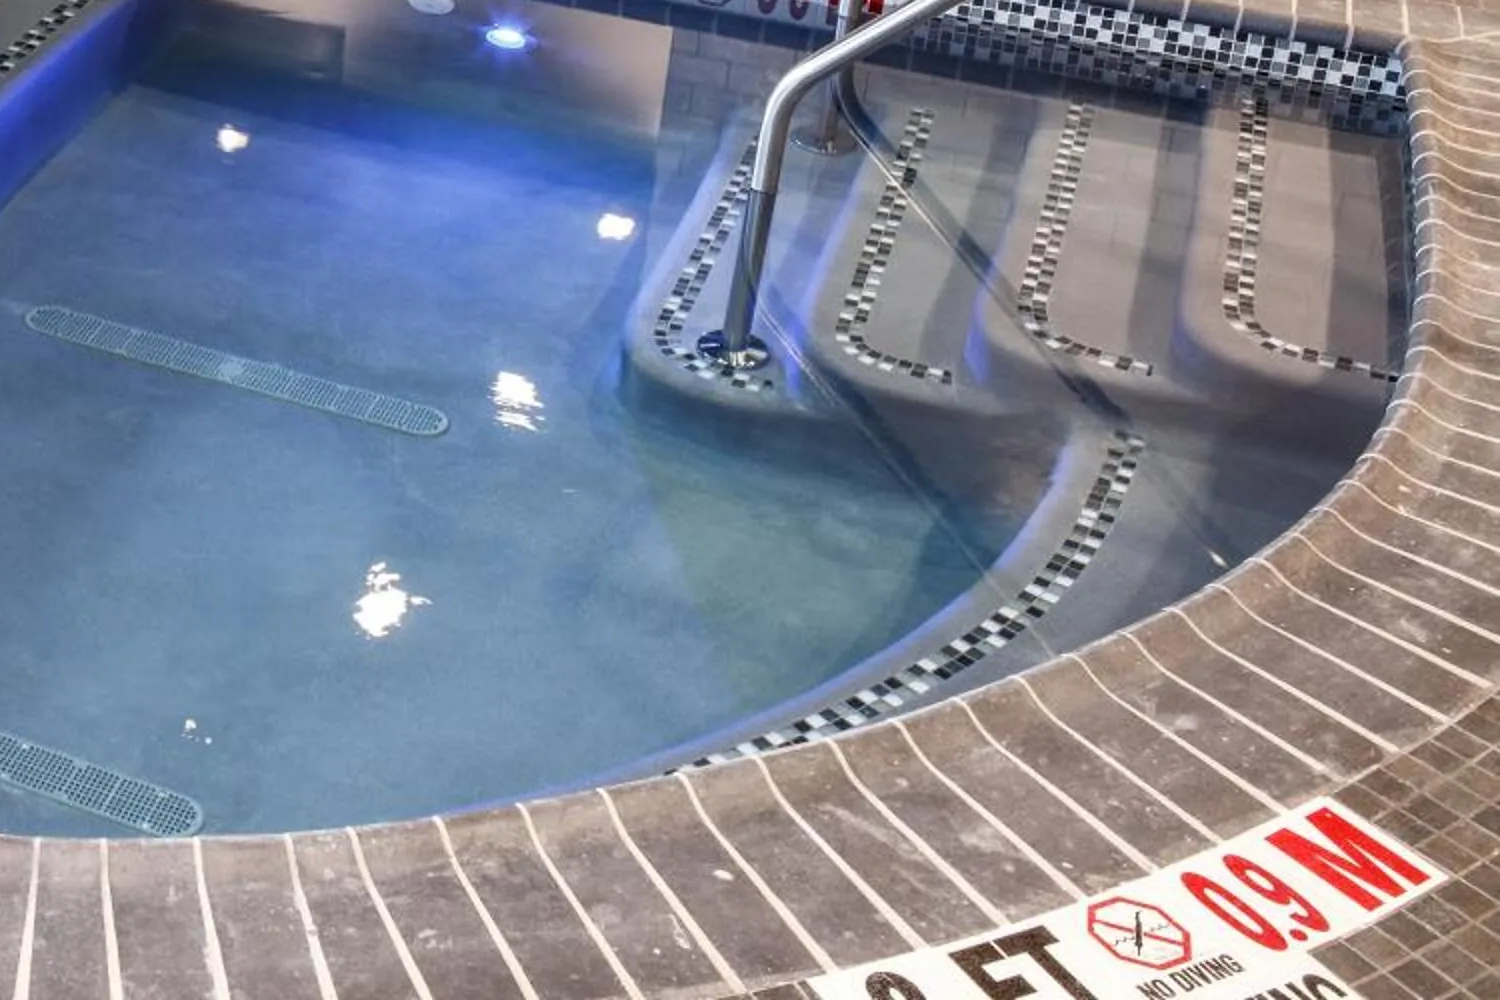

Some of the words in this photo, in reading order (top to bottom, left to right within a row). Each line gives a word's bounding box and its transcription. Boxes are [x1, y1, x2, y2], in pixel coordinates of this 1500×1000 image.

[1180, 854, 1330, 951] 0.9
[1264, 806, 1430, 912] M
[1136, 979, 1177, 1000] NO
[1167, 954, 1245, 993] DIVING
